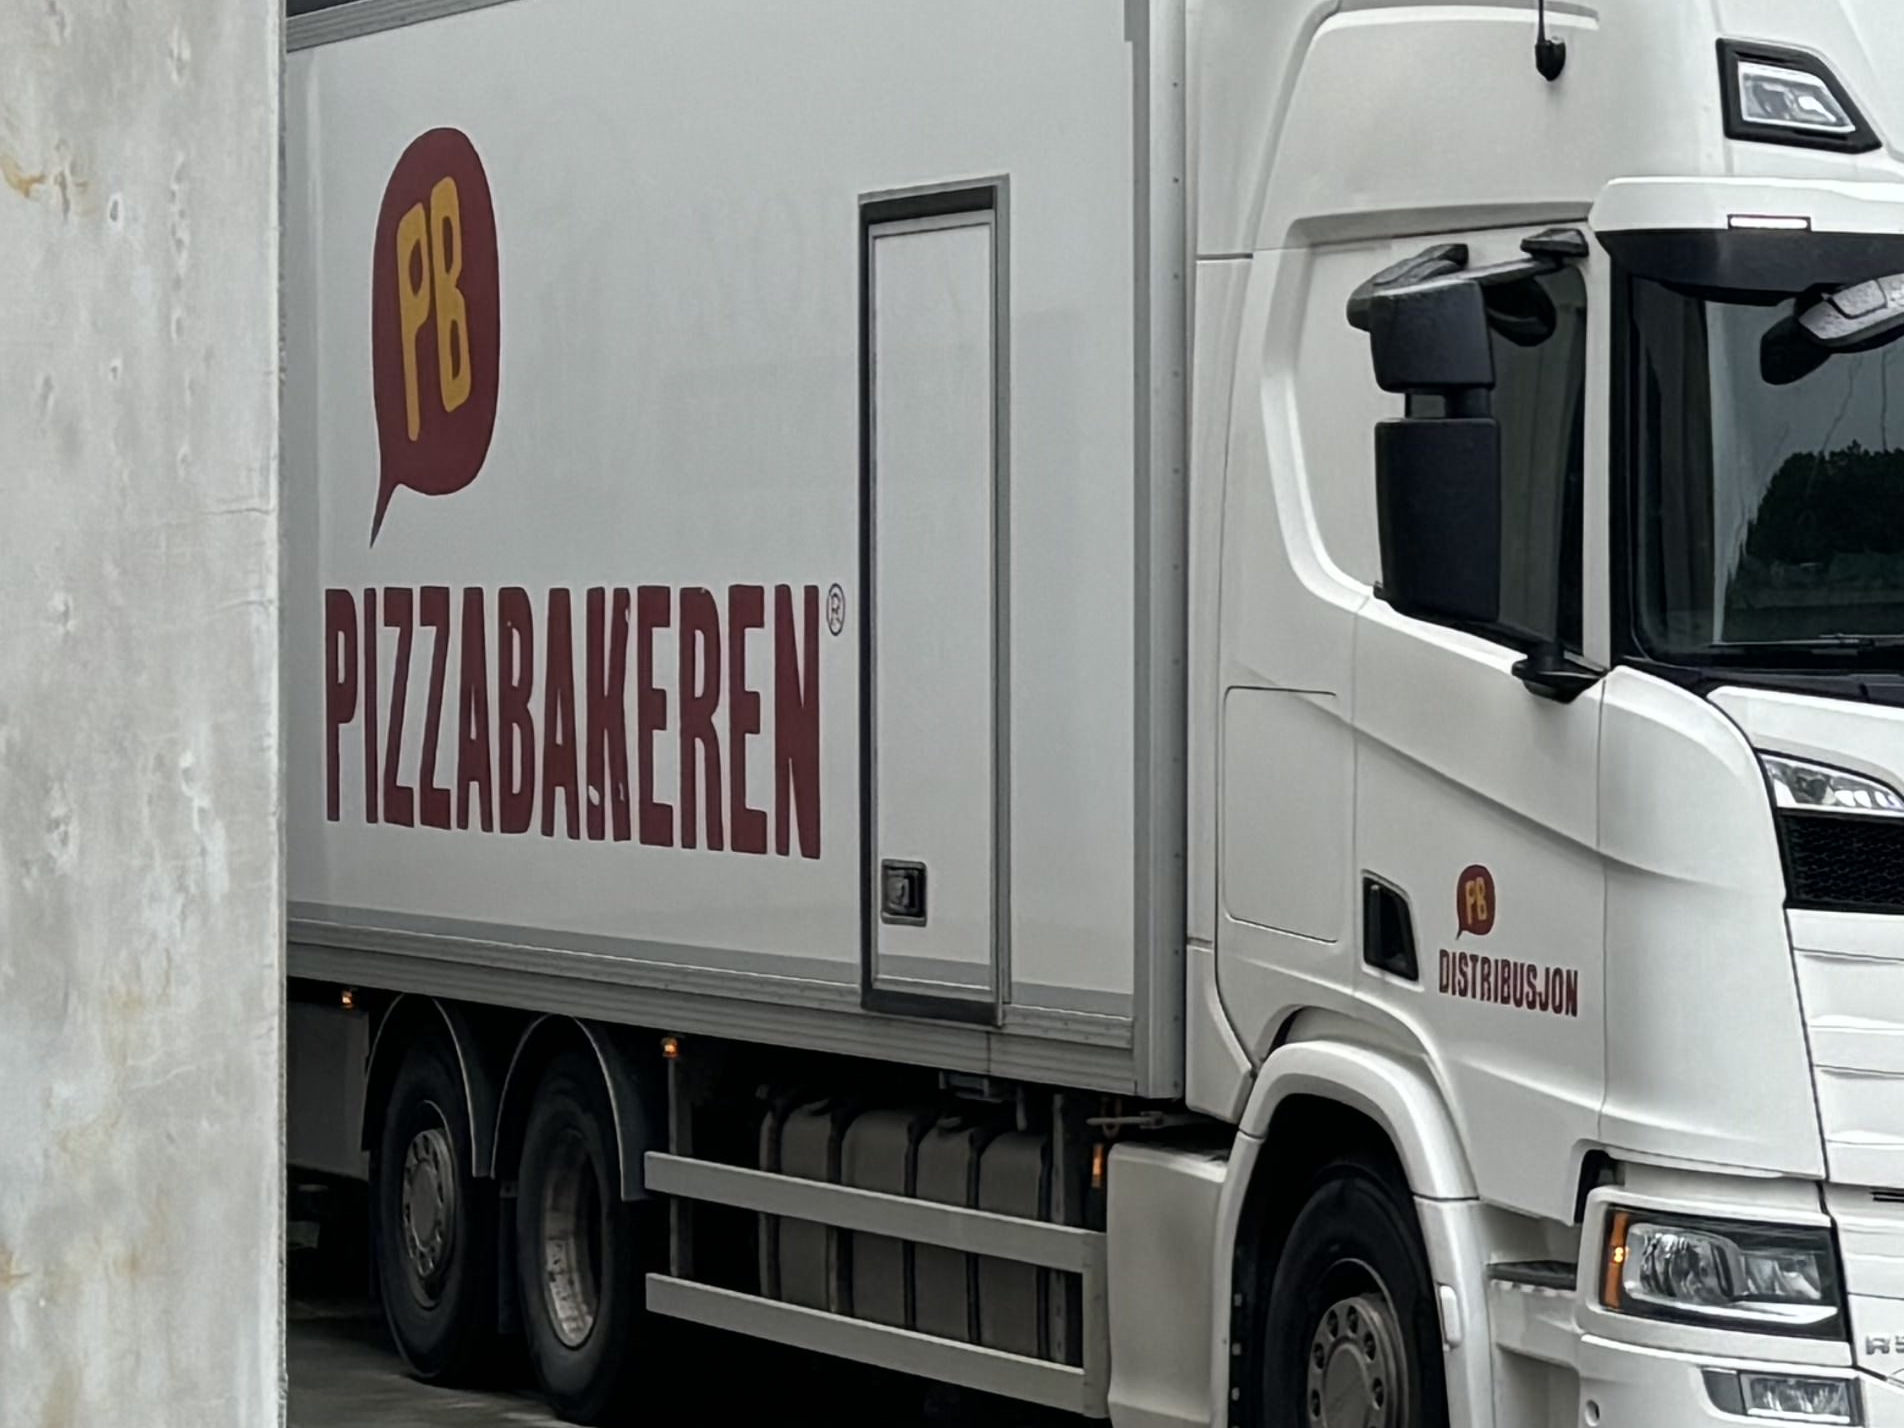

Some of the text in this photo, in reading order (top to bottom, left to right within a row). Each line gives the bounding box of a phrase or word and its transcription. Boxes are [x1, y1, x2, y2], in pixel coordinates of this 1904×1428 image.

[396, 177, 471, 442] PB
[325, 583, 821, 860] PIZZABAKEREN
[1439, 949, 1578, 1018] DISTRIBUSJON
[1465, 876, 1488, 925] PB
